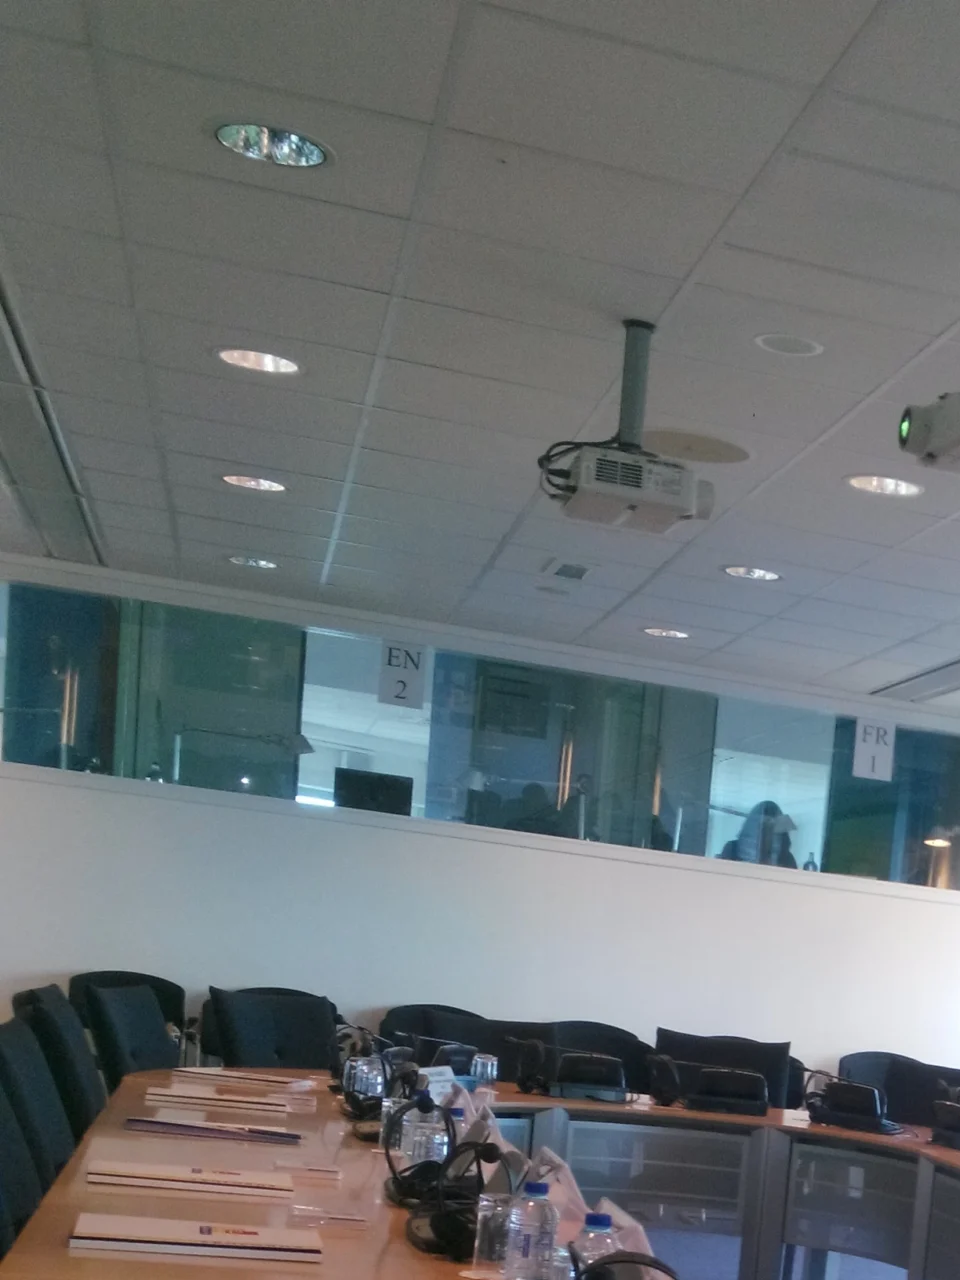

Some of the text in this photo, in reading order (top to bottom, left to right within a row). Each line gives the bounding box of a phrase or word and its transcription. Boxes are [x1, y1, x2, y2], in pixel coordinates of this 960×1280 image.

[386, 646, 422, 671] EN
[394, 679, 407, 700] 2
[862, 724, 889, 748] FR
